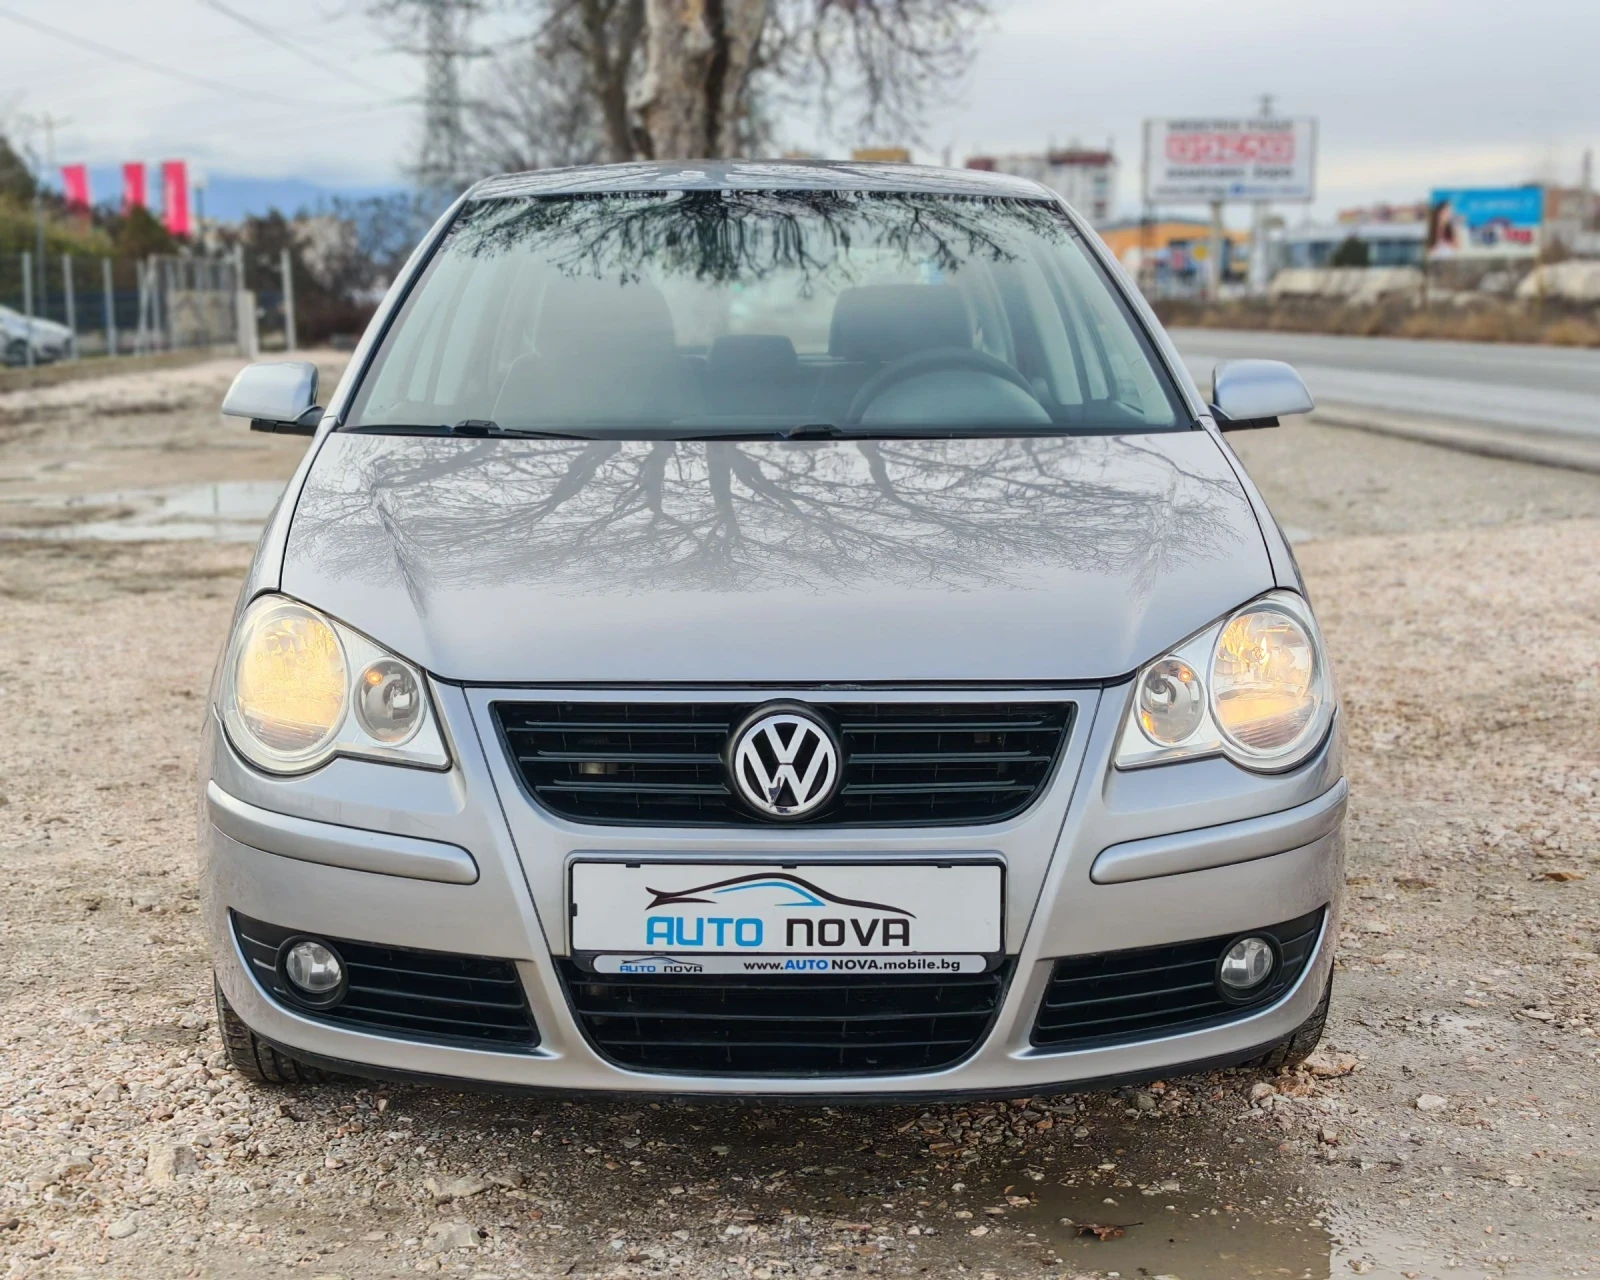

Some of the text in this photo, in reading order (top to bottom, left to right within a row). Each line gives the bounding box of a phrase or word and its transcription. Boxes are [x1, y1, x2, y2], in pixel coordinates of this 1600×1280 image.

[740, 718, 832, 811] VW
[646, 916, 911, 947] AUTO NOVA
[619, 965, 703, 973] AUTO NOVA
